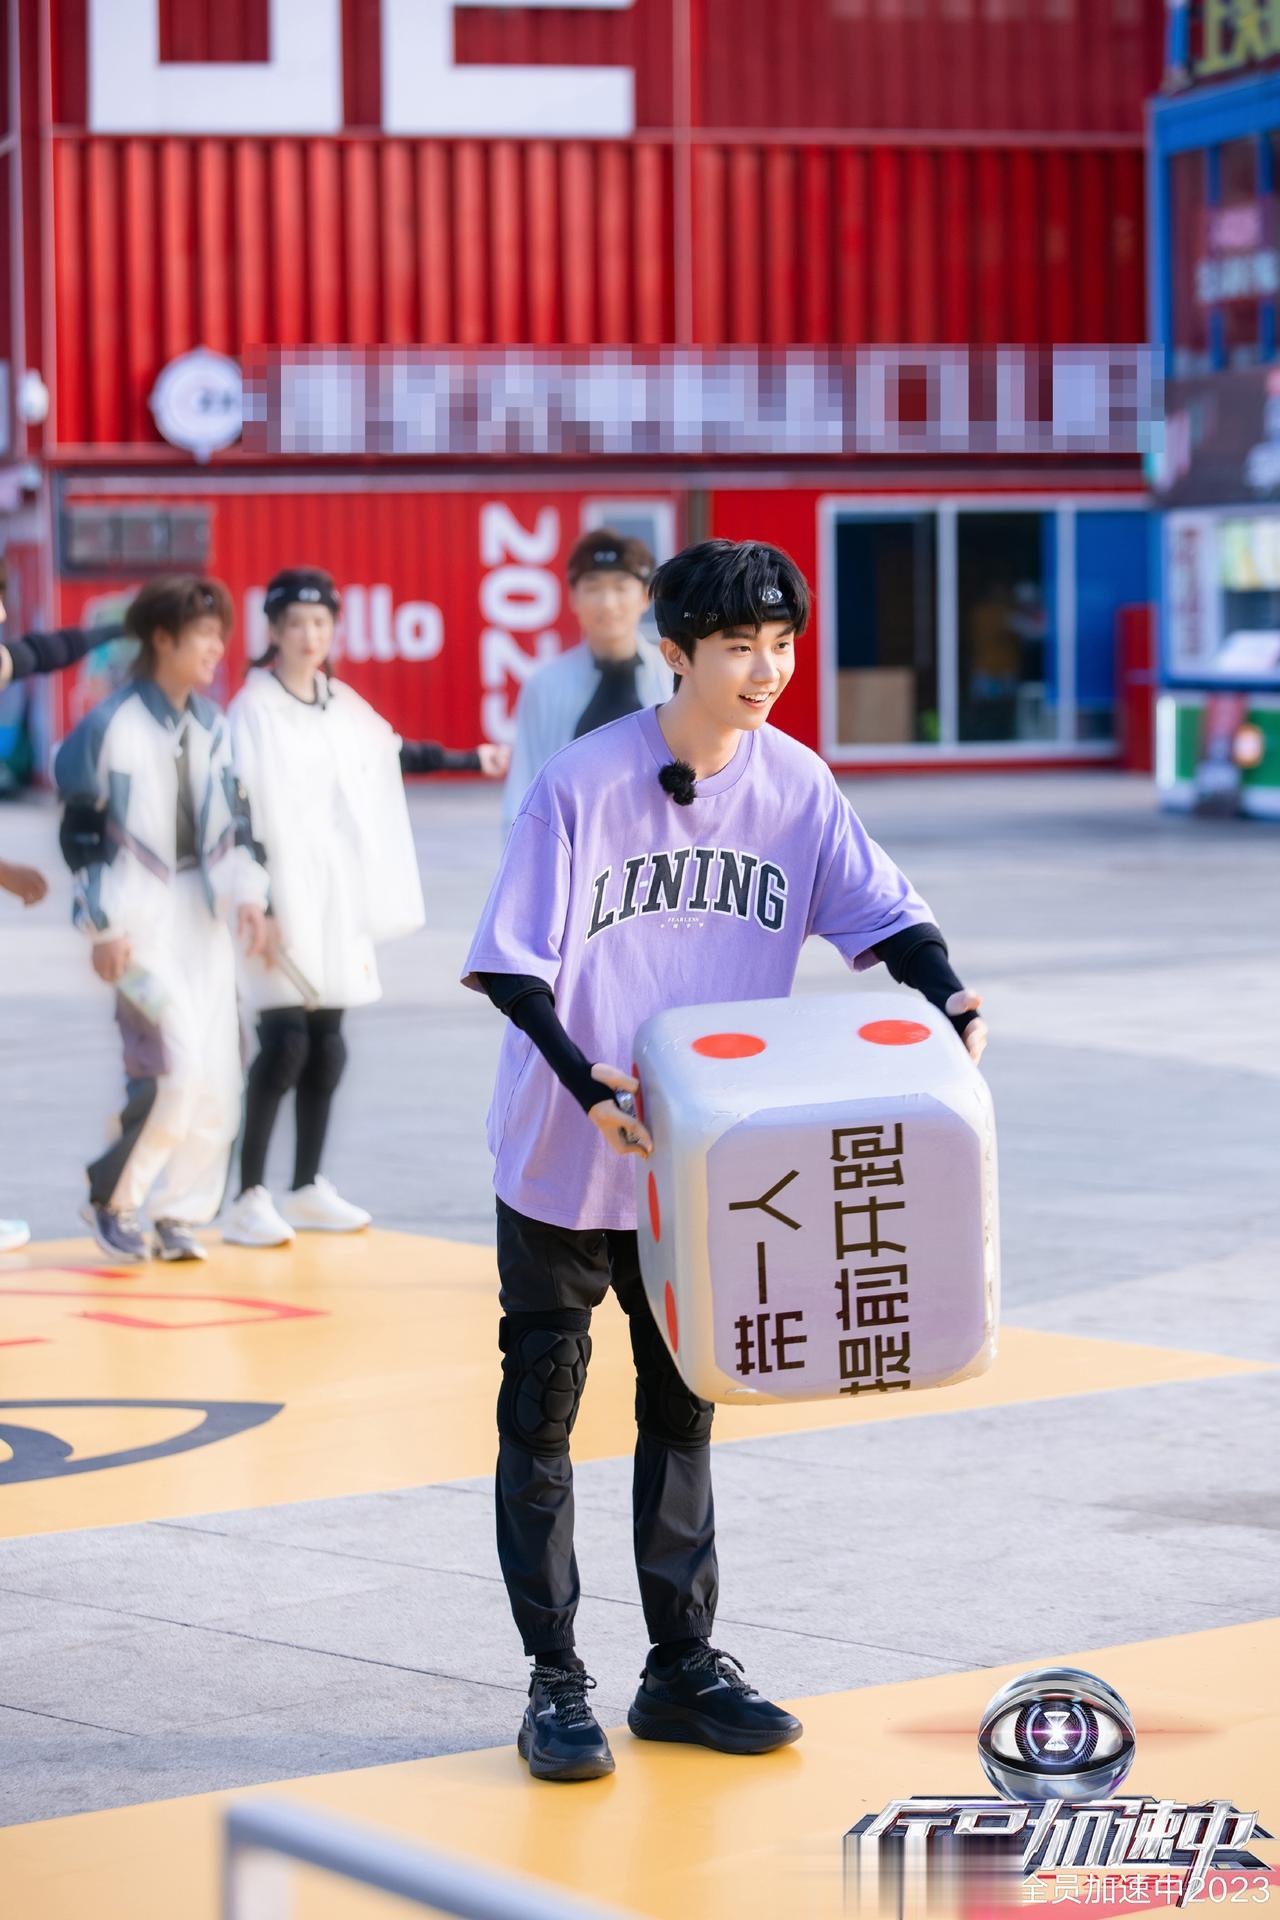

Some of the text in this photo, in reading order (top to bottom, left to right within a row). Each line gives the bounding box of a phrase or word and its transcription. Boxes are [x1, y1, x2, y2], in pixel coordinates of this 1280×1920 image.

[245, 585, 444, 662] llo
[728, 1169, 808, 1376] 带一人
[830, 1122, 911, 1396] 提前开跑
